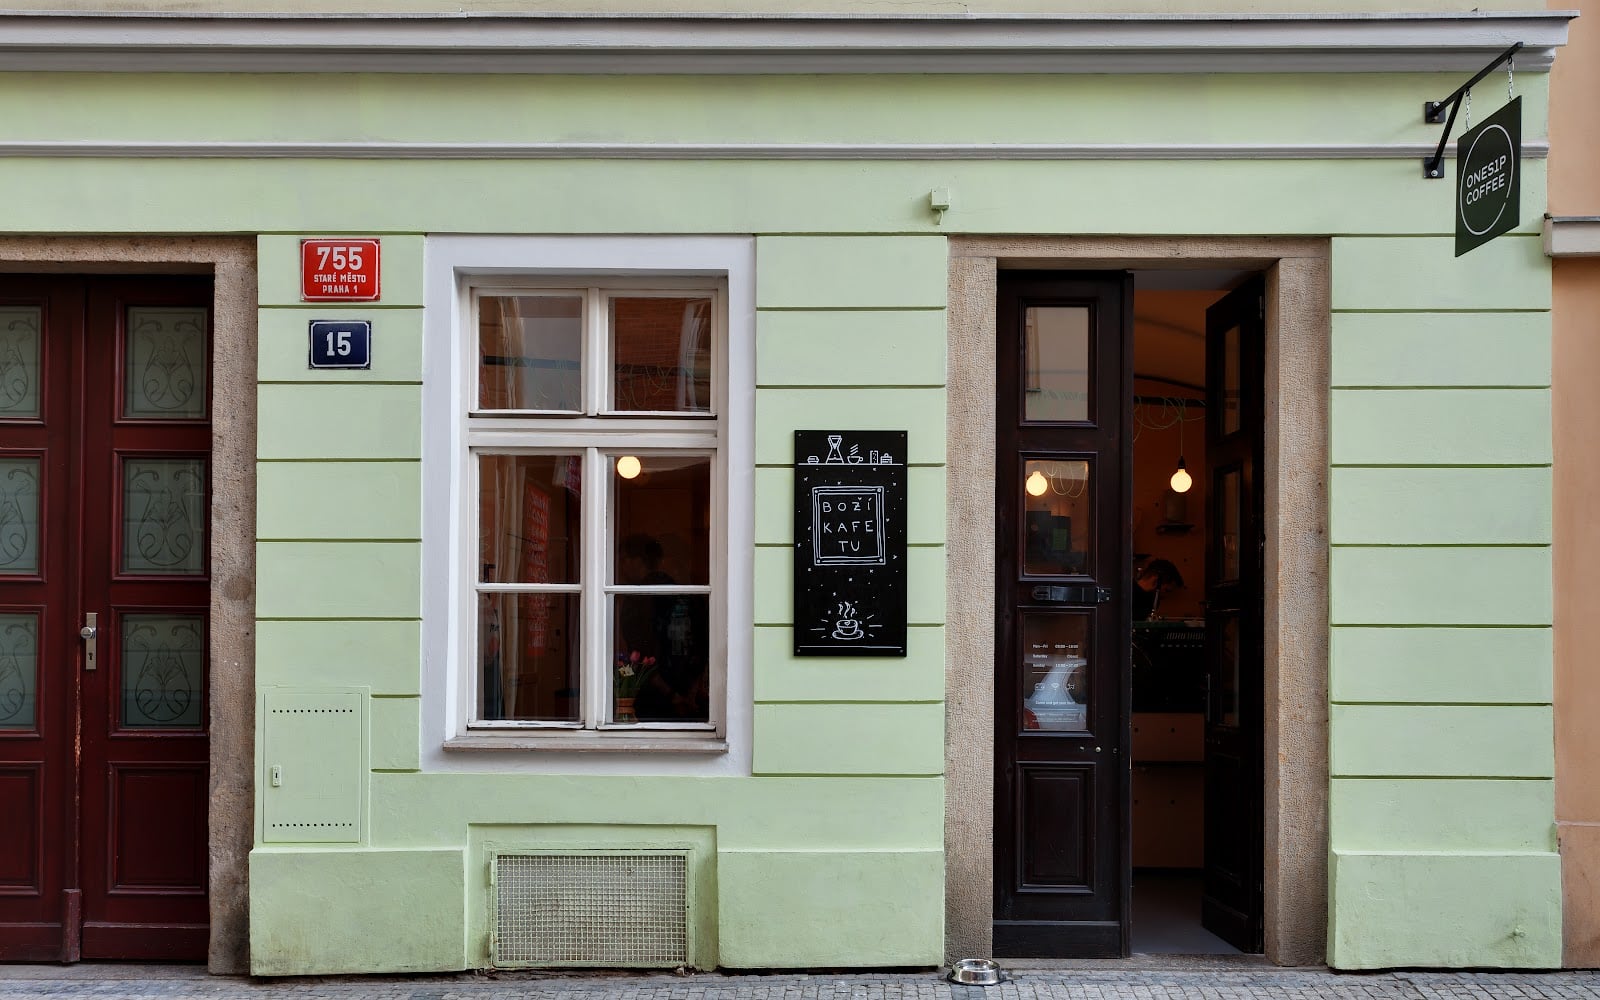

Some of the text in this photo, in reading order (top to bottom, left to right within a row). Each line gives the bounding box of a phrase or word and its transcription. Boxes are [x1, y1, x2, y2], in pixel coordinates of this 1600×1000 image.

[1466, 172, 1505, 205] COFFEE
[317, 246, 363, 271] 755
[313, 272, 367, 283] STARÉ MĚSTO
[322, 284, 358, 294] PRAHA 1
[326, 331, 352, 357] 15
[822, 496, 872, 513] BOŽÍ
[823, 520, 874, 534] KAFE
[837, 540, 860, 553] TU
